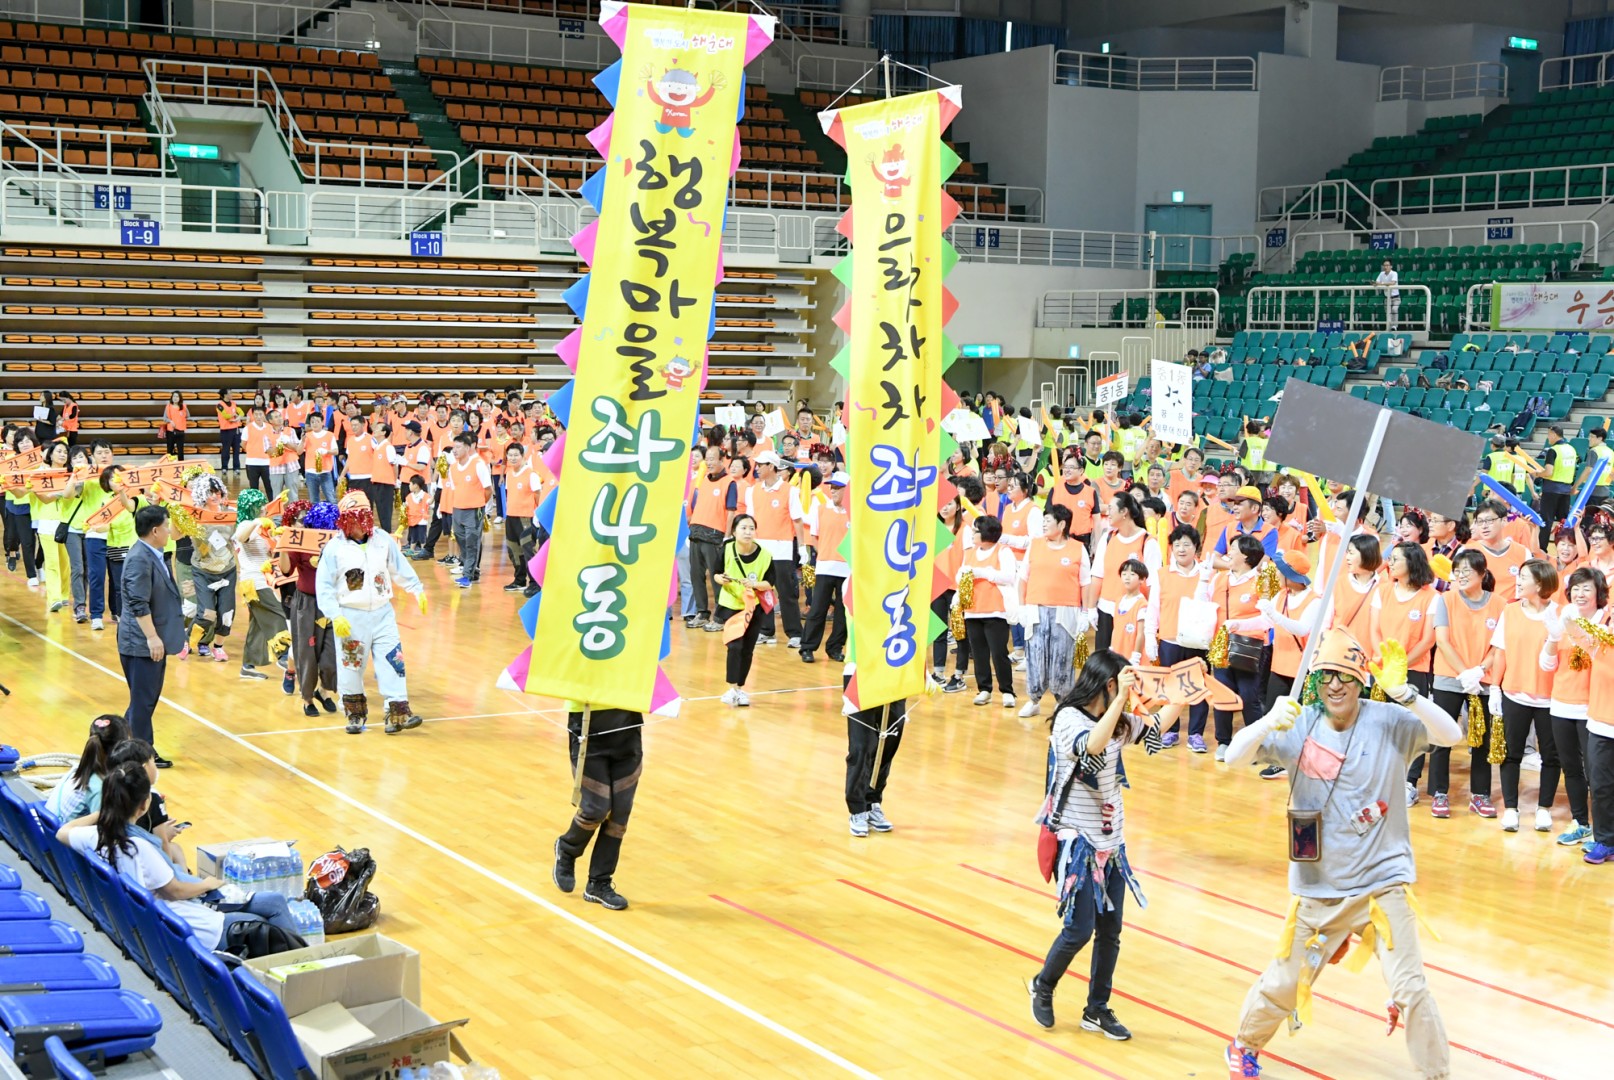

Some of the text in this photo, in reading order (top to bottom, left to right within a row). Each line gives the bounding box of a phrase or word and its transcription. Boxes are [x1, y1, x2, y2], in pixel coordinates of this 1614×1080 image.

[692, 33, 733, 53] 해운대
[126, 229, 153, 244] 1-9
[1490, 226, 1508, 238] 3-14
[414, 241, 440, 255] 1-10
[1267, 236, 1283, 246] 3-13
[616, 139, 703, 401] 행복마을
[1533, 291, 1559, 304] 해운대
[1100, 380, 1124, 403] 중1동
[169, 487, 183, 502] 최
[573, 395, 686, 661] 좌4동
